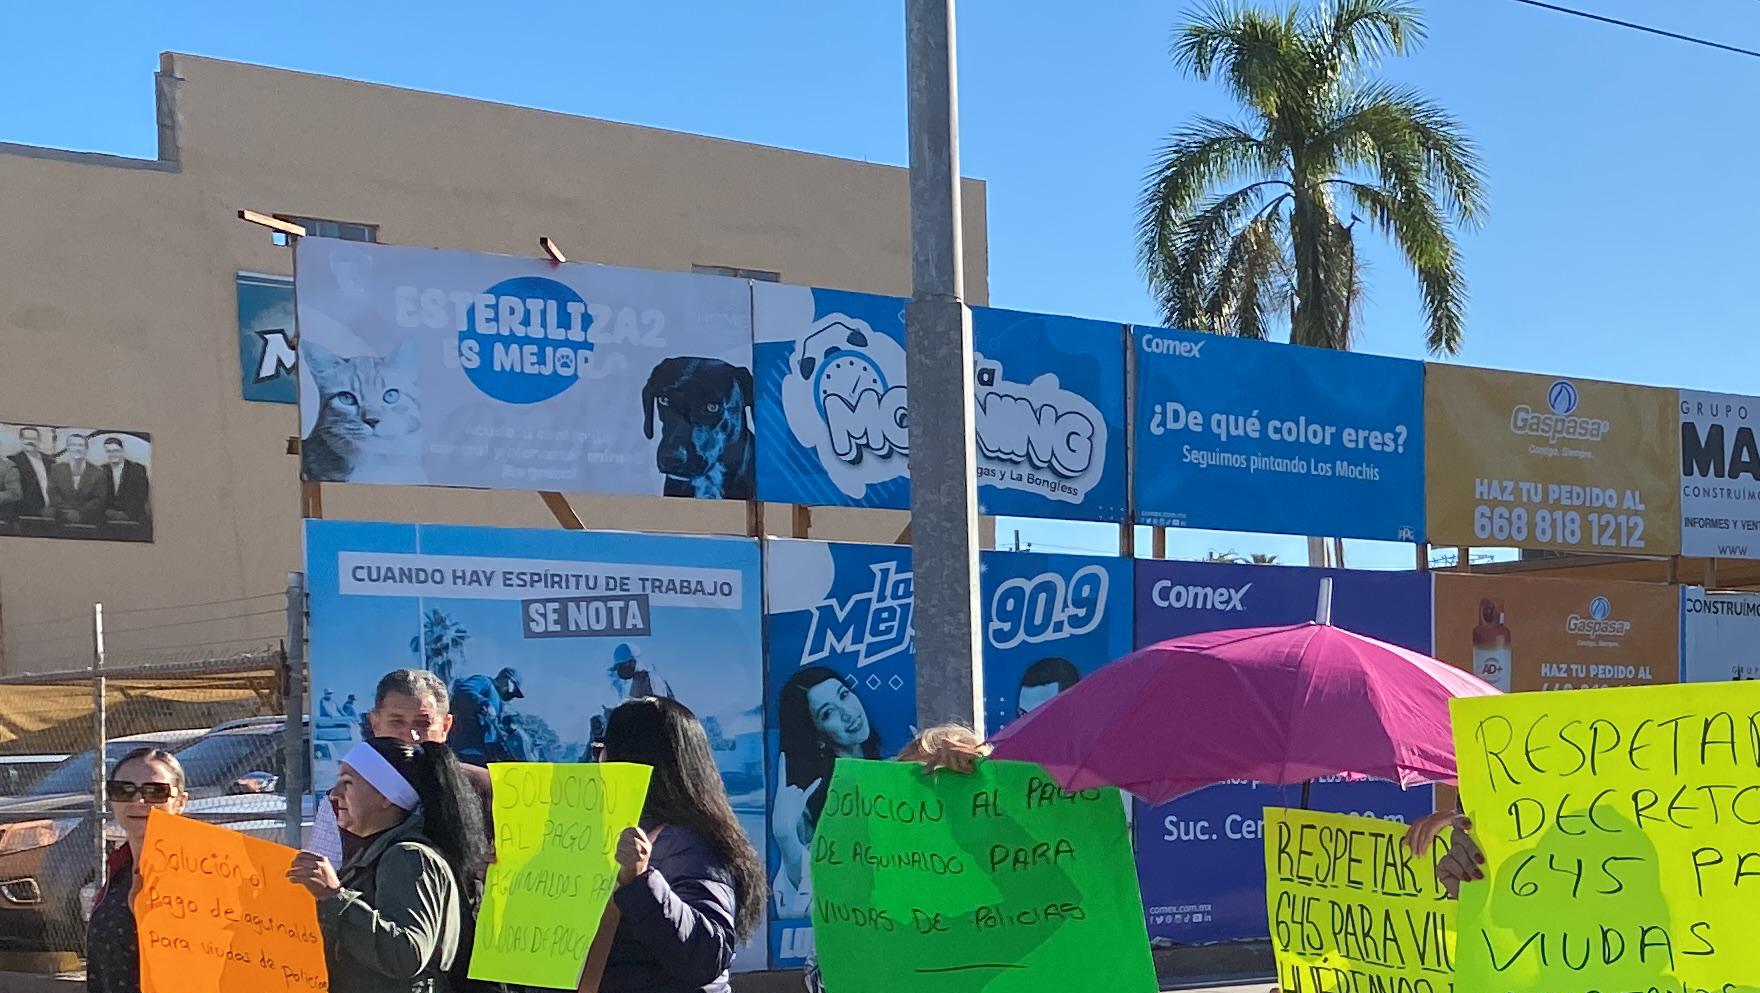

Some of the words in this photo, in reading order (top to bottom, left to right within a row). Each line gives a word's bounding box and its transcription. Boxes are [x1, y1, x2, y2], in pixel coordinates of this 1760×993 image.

[1141, 333, 1205, 358] Comex
[1511, 404, 1602, 444] Gaspasa
[1680, 400, 1748, 420] GRUPO
[1149, 401, 1203, 436] ¿De
[1210, 410, 1260, 441] qué
[1266, 416, 1337, 445] color
[1342, 424, 1408, 454] eres?
[999, 470, 1006, 481] y
[1010, 470, 1023, 482] La
[1182, 444, 1247, 469] Seguimos
[1250, 453, 1307, 474] pintando
[1310, 458, 1332, 476] Los
[1335, 461, 1380, 481] Mochis
[1475, 478, 1514, 501] HAZ
[1519, 482, 1542, 503] TU
[1548, 484, 1618, 509] PEDIDO
[1622, 490, 1646, 511] AL
[1474, 505, 1528, 541] 668
[1535, 509, 1582, 545] 818
[1588, 513, 1646, 548] 1212
[1684, 517, 1730, 530] INFORMES
[1732, 519, 1738, 530] Y
[351, 564, 445, 585] CUANDO
[452, 569, 495, 587] HAY
[502, 567, 599, 592] ESPÍRITU
[604, 575, 632, 593] DE
[639, 577, 734, 598] TRABAJO
[1151, 579, 1253, 611] Comex
[528, 602, 560, 633] SE
[567, 599, 644, 632] NOTA
[988, 564, 1110, 650] 90.9
[1566, 614, 1624, 638] Gaspasa
[1541, 663, 1567, 677] HAZ
[1570, 664, 1586, 677] TU
[1589, 665, 1635, 679] PEDIDO
[1638, 667, 1652, 679] AL
[972, 788, 1004, 818] AL
[500, 822, 530, 850] AL
[543, 820, 592, 851] PAGO
[1163, 815, 1218, 841] Suc.
[815, 835, 843, 865] DE
[989, 839, 1076, 872] PARA
[1277, 821, 1422, 897] RESPETAR
[1510, 853, 1647, 900] 645
[816, 898, 895, 932] VIUDAS
[911, 908, 950, 934] DE
[1275, 890, 1325, 955] 645
[1328, 899, 1405, 966] PARA
[1480, 922, 1718, 972] VIUDAS
